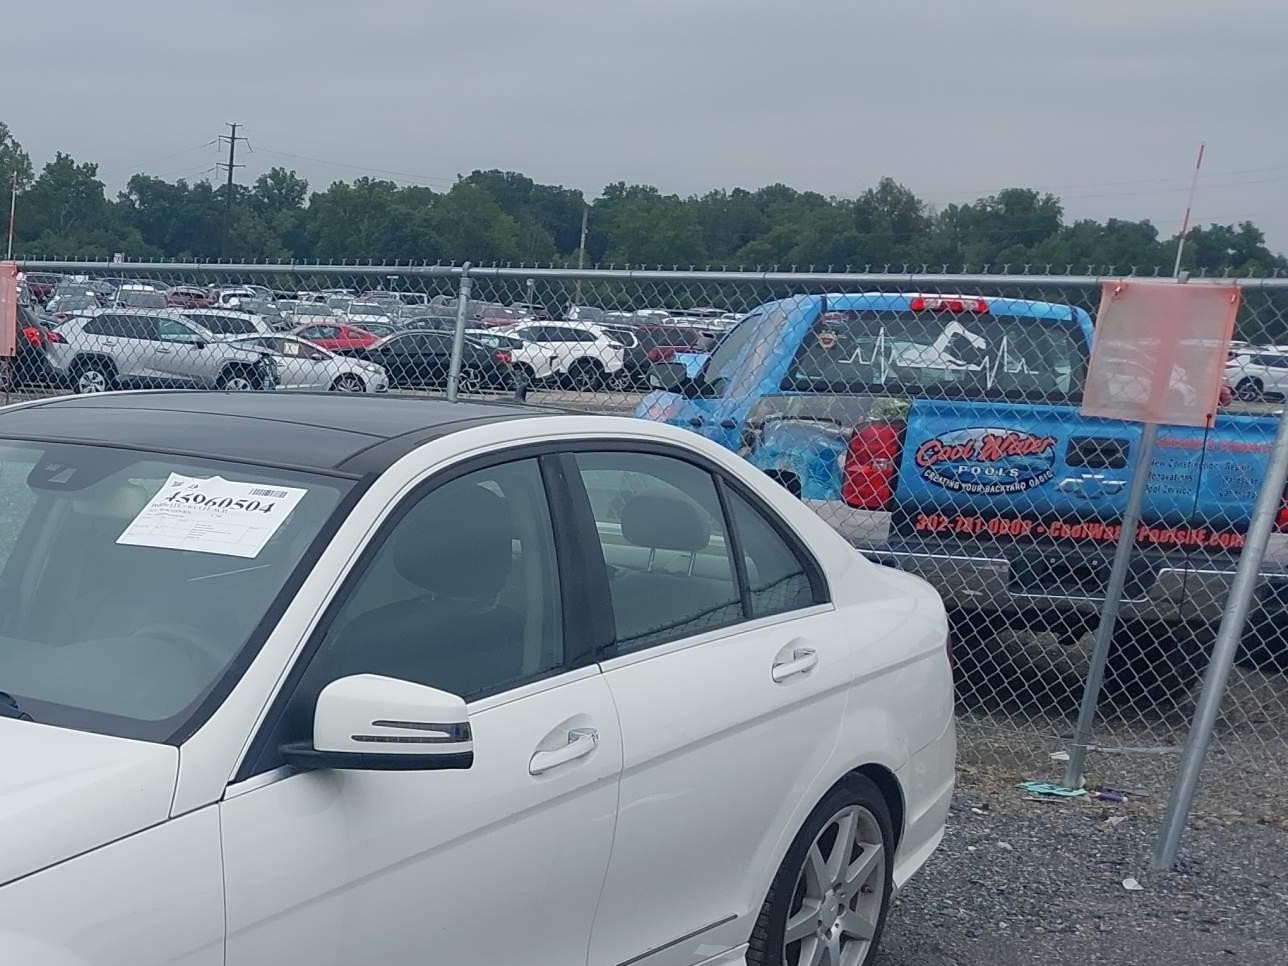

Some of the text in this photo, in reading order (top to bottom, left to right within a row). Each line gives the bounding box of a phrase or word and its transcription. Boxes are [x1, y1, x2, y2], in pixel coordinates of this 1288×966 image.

[915, 432, 1057, 467] Cool Water
[924, 469, 960, 490] CREATING
[961, 483, 984, 493] YOUR
[985, 481, 1026, 494] BACKYARD
[958, 465, 1020, 477] POOLS
